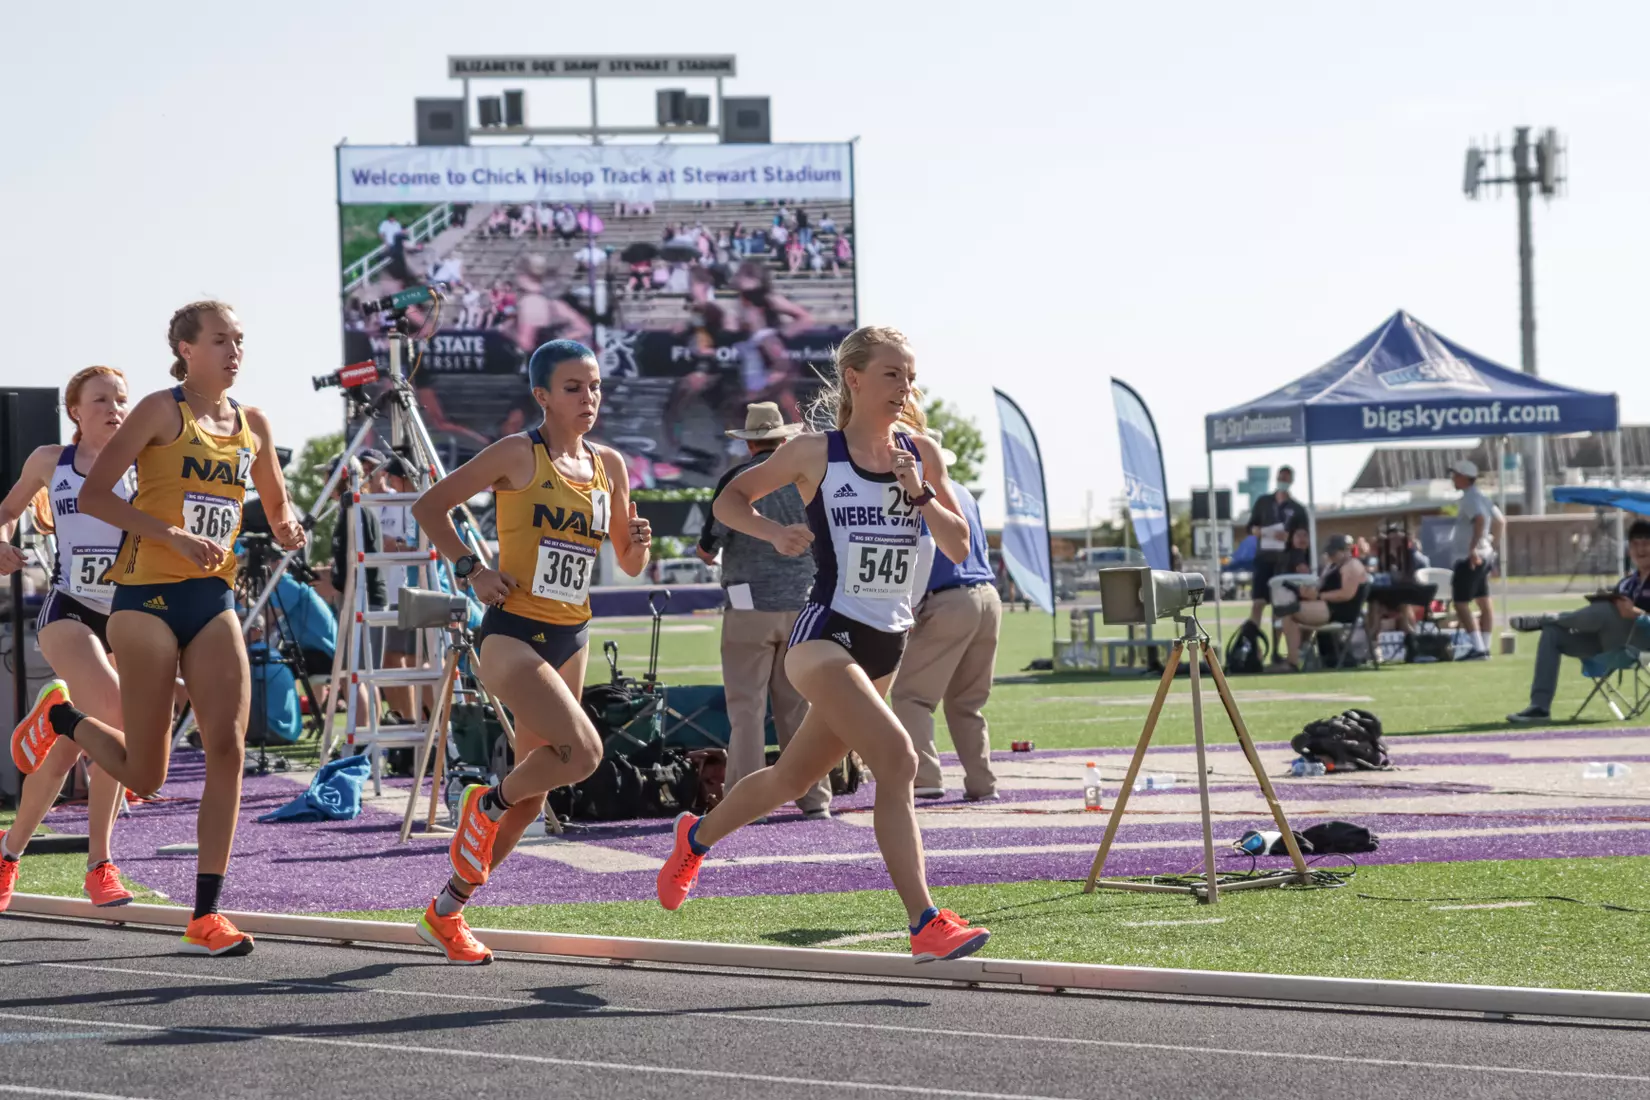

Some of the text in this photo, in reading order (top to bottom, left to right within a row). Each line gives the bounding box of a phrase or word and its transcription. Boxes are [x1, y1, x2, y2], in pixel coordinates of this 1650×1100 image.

[454, 59, 525, 73] ELIZABETH
[563, 59, 600, 72] SHAW
[609, 59, 669, 72] STEWART
[677, 59, 731, 72] STADIUM
[352, 165, 842, 188] Welcome to Chick Hislop Track at Stewart Stadium
[434, 336, 485, 353] STATE
[1244, 413, 1292, 436] Conference
[1362, 401, 1560, 432] bigskyconf.com
[190, 504, 232, 538] 366
[598, 494, 606, 530] 1
[831, 506, 888, 527] WEBER
[543, 551, 587, 591] 363
[859, 546, 909, 585] 545
[143, 601, 168, 610] adidas
